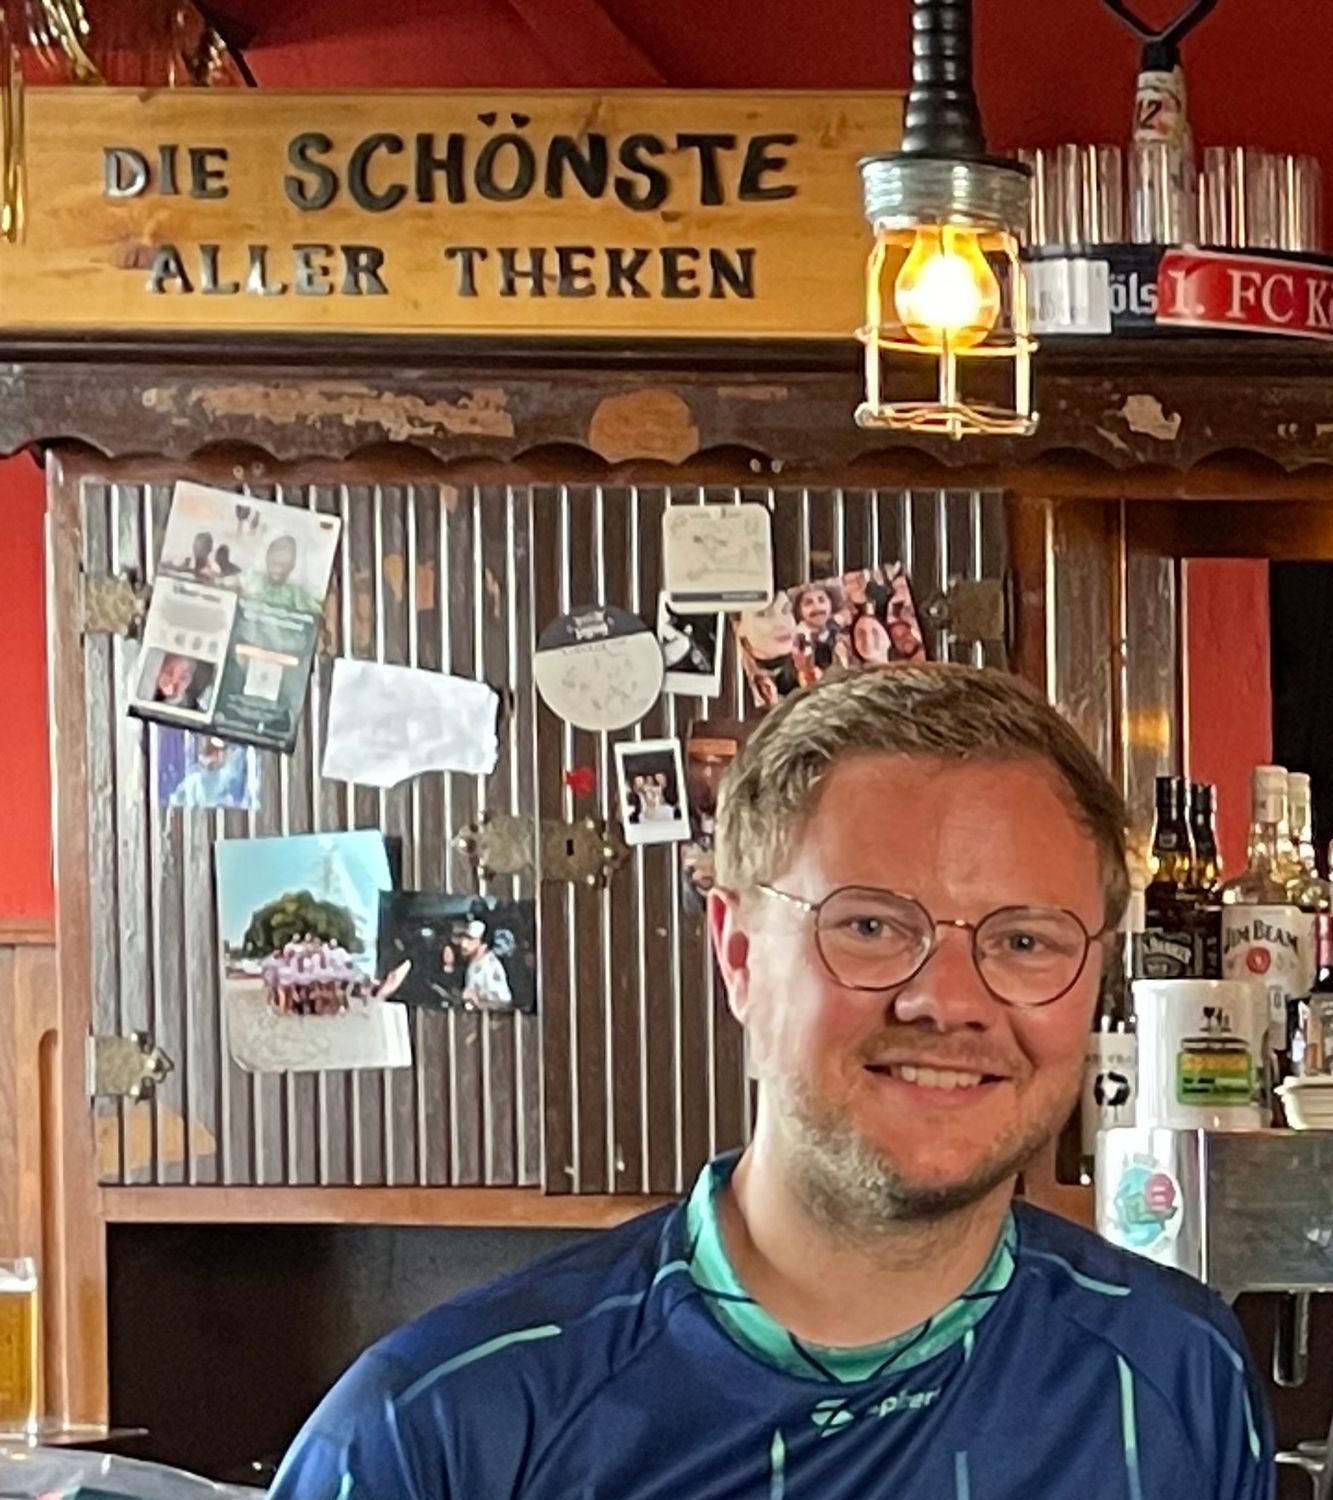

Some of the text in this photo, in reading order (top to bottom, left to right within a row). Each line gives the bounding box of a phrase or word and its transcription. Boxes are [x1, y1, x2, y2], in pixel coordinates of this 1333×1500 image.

[103, 111, 800, 213] DIE SCHÖNSTE
[146, 243, 758, 300] ALLER THEKEN
[1226, 268, 1294, 325] FC
